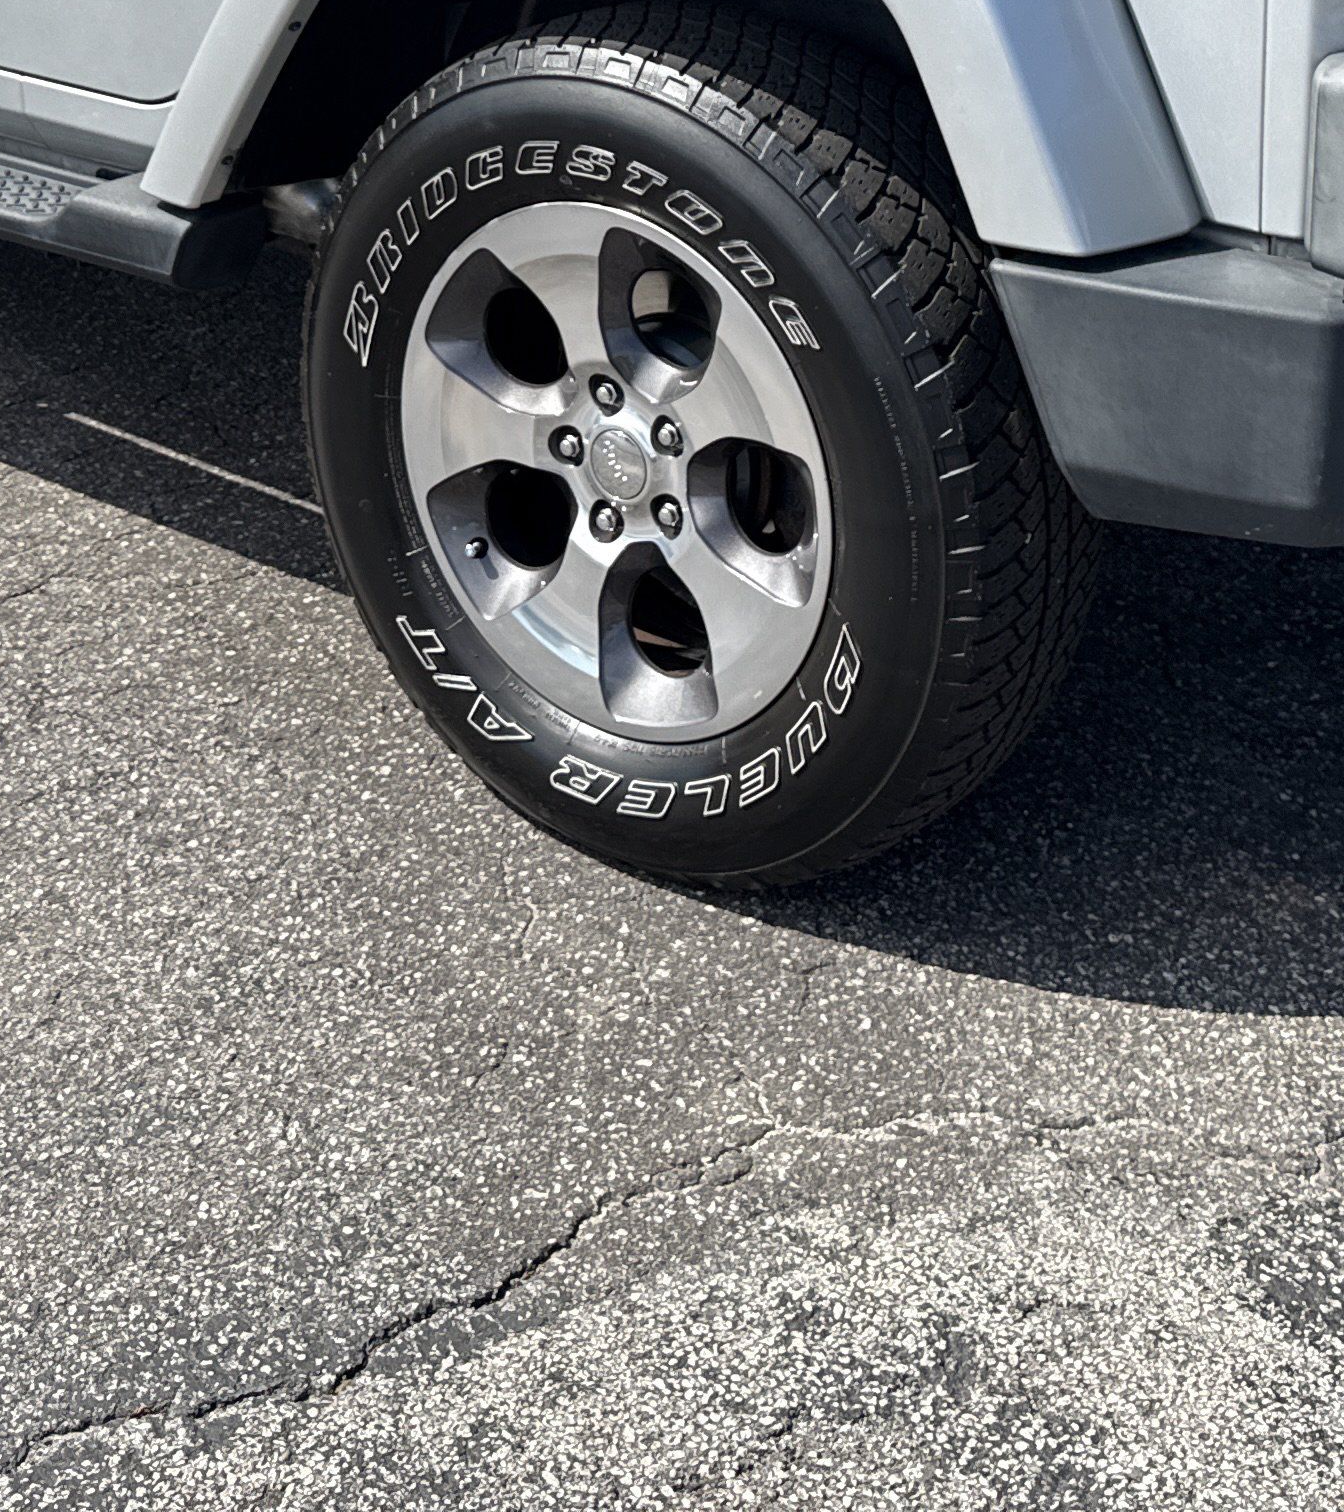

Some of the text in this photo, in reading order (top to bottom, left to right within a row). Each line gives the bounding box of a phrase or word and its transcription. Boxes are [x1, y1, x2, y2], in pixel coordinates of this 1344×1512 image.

[342, 139, 823, 367] BRIDGESTONE
[395, 614, 864, 819] DUELER A/T
